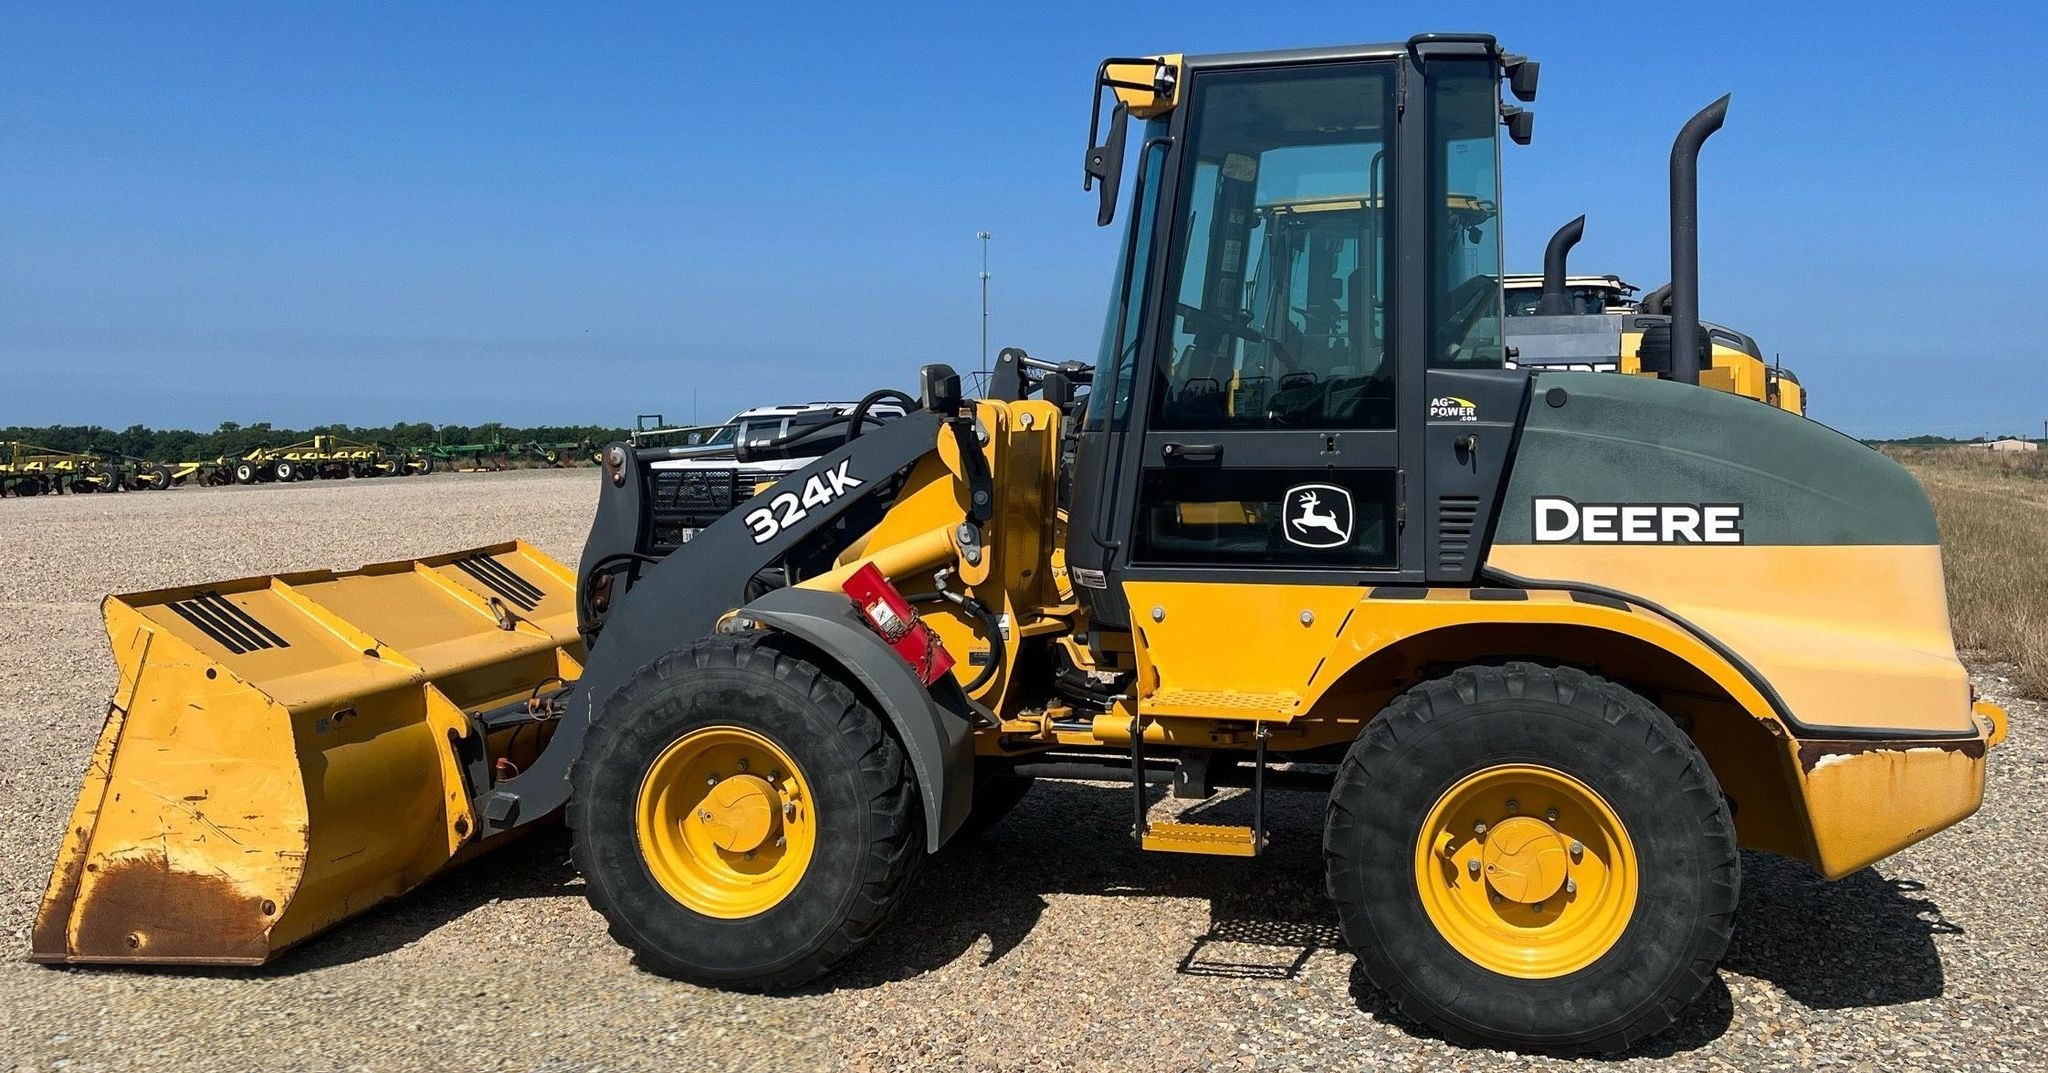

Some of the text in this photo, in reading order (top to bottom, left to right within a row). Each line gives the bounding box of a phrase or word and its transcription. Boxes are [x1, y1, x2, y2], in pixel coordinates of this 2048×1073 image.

[1430, 407, 1475, 416] POWER
[1431, 397, 1455, 407] AG-
[744, 459, 863, 544] 324K
[1534, 498, 1741, 543] DEERE
